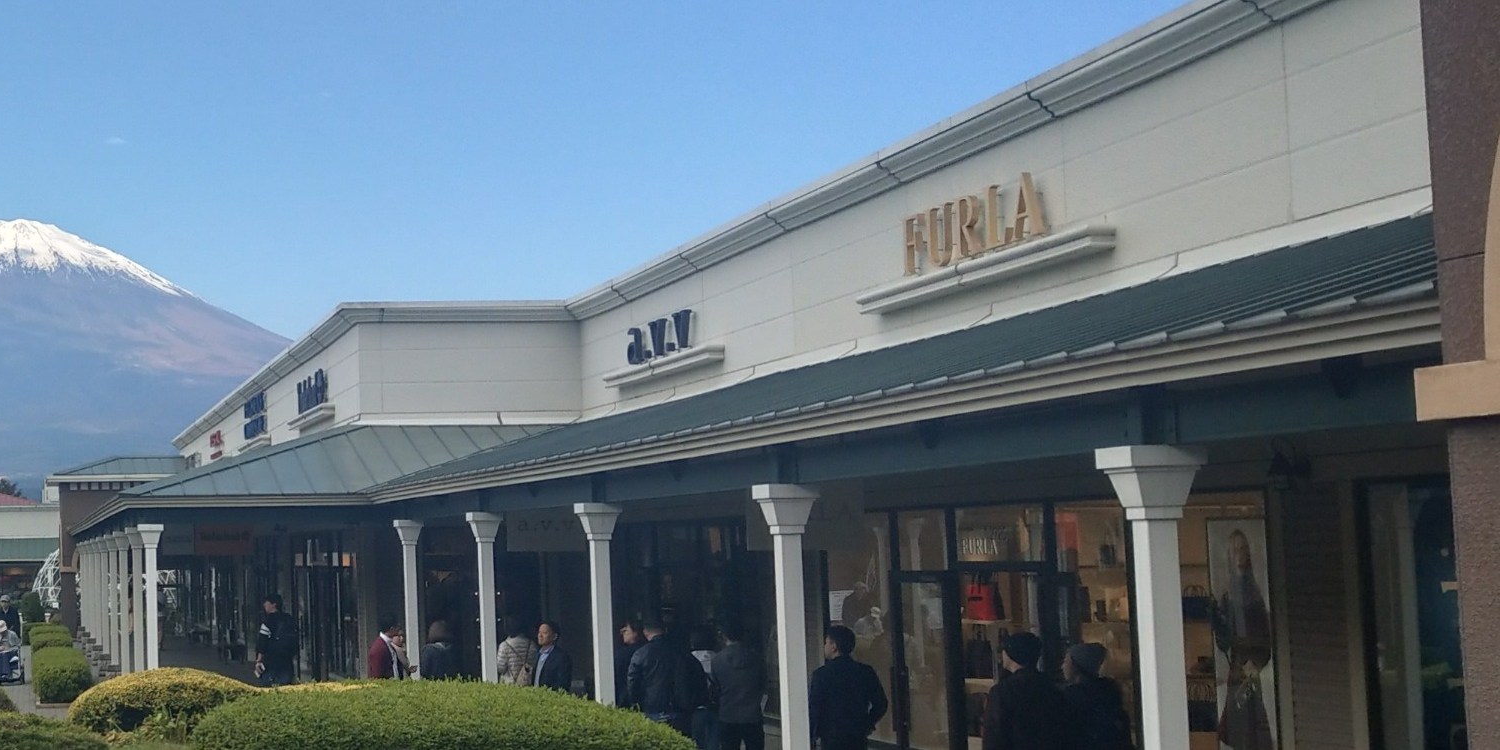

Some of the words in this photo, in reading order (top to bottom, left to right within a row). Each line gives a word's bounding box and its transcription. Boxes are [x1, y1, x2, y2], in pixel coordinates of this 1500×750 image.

[904, 172, 1048, 277] FURLA
[627, 310, 692, 365] a.v.v
[962, 537, 999, 555] FURLA
